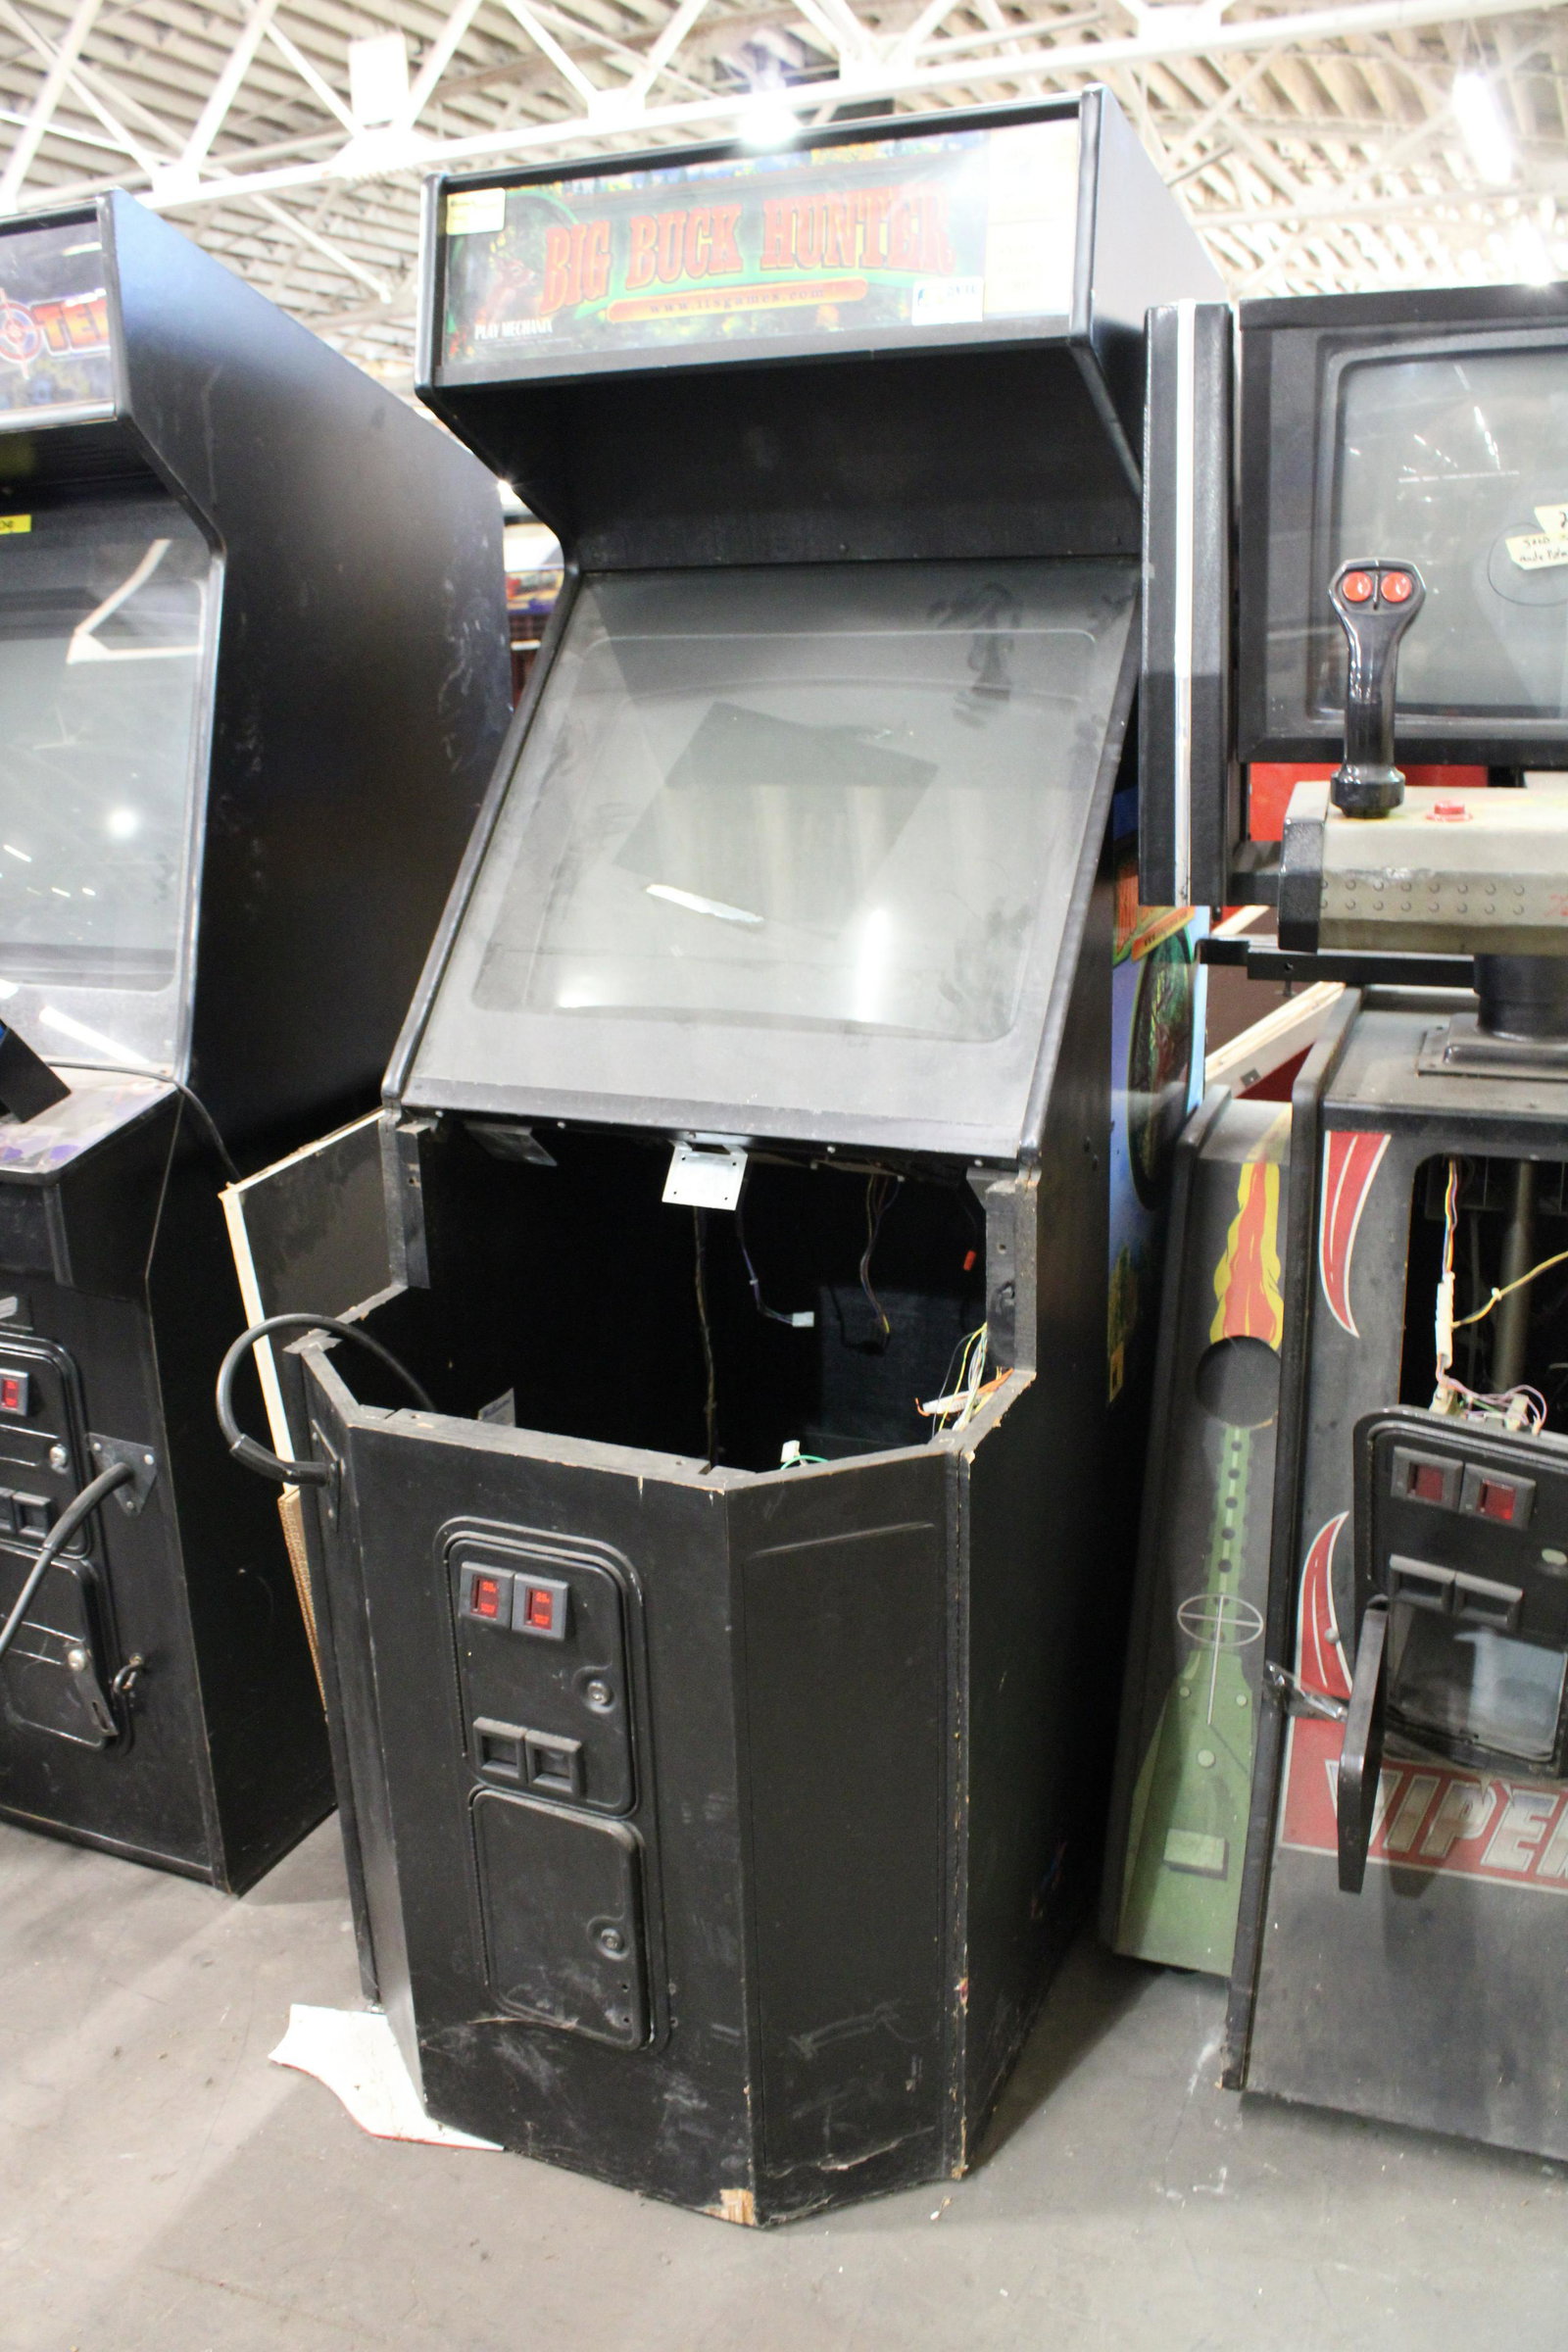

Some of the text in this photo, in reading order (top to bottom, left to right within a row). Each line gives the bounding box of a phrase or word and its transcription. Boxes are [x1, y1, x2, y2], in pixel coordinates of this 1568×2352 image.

[539, 219, 612, 315] BIG
[625, 203, 744, 289] BUCK
[759, 179, 956, 277] HUNTER
[474, 322, 499, 341] PLAY
